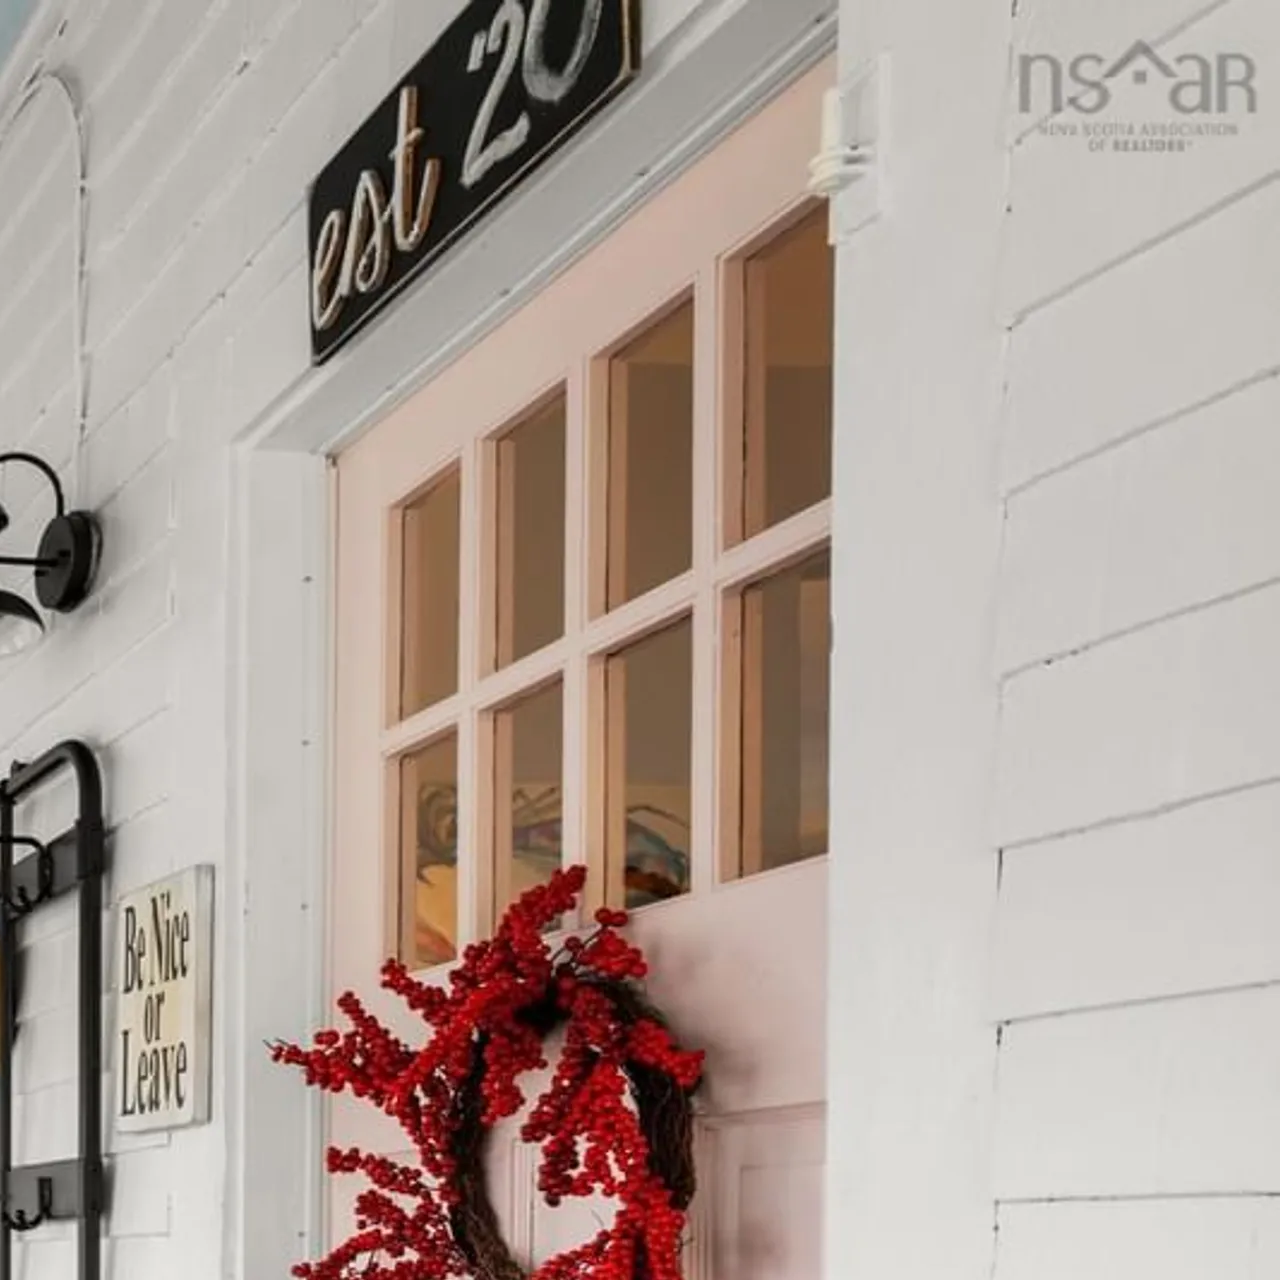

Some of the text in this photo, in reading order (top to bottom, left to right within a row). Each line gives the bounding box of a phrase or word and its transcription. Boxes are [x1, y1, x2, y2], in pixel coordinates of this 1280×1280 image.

[313, 85, 440, 330] est
[123, 890, 190, 994] Be Nice
[144, 991, 165, 1045] or
[121, 1028, 188, 1117] Leave
